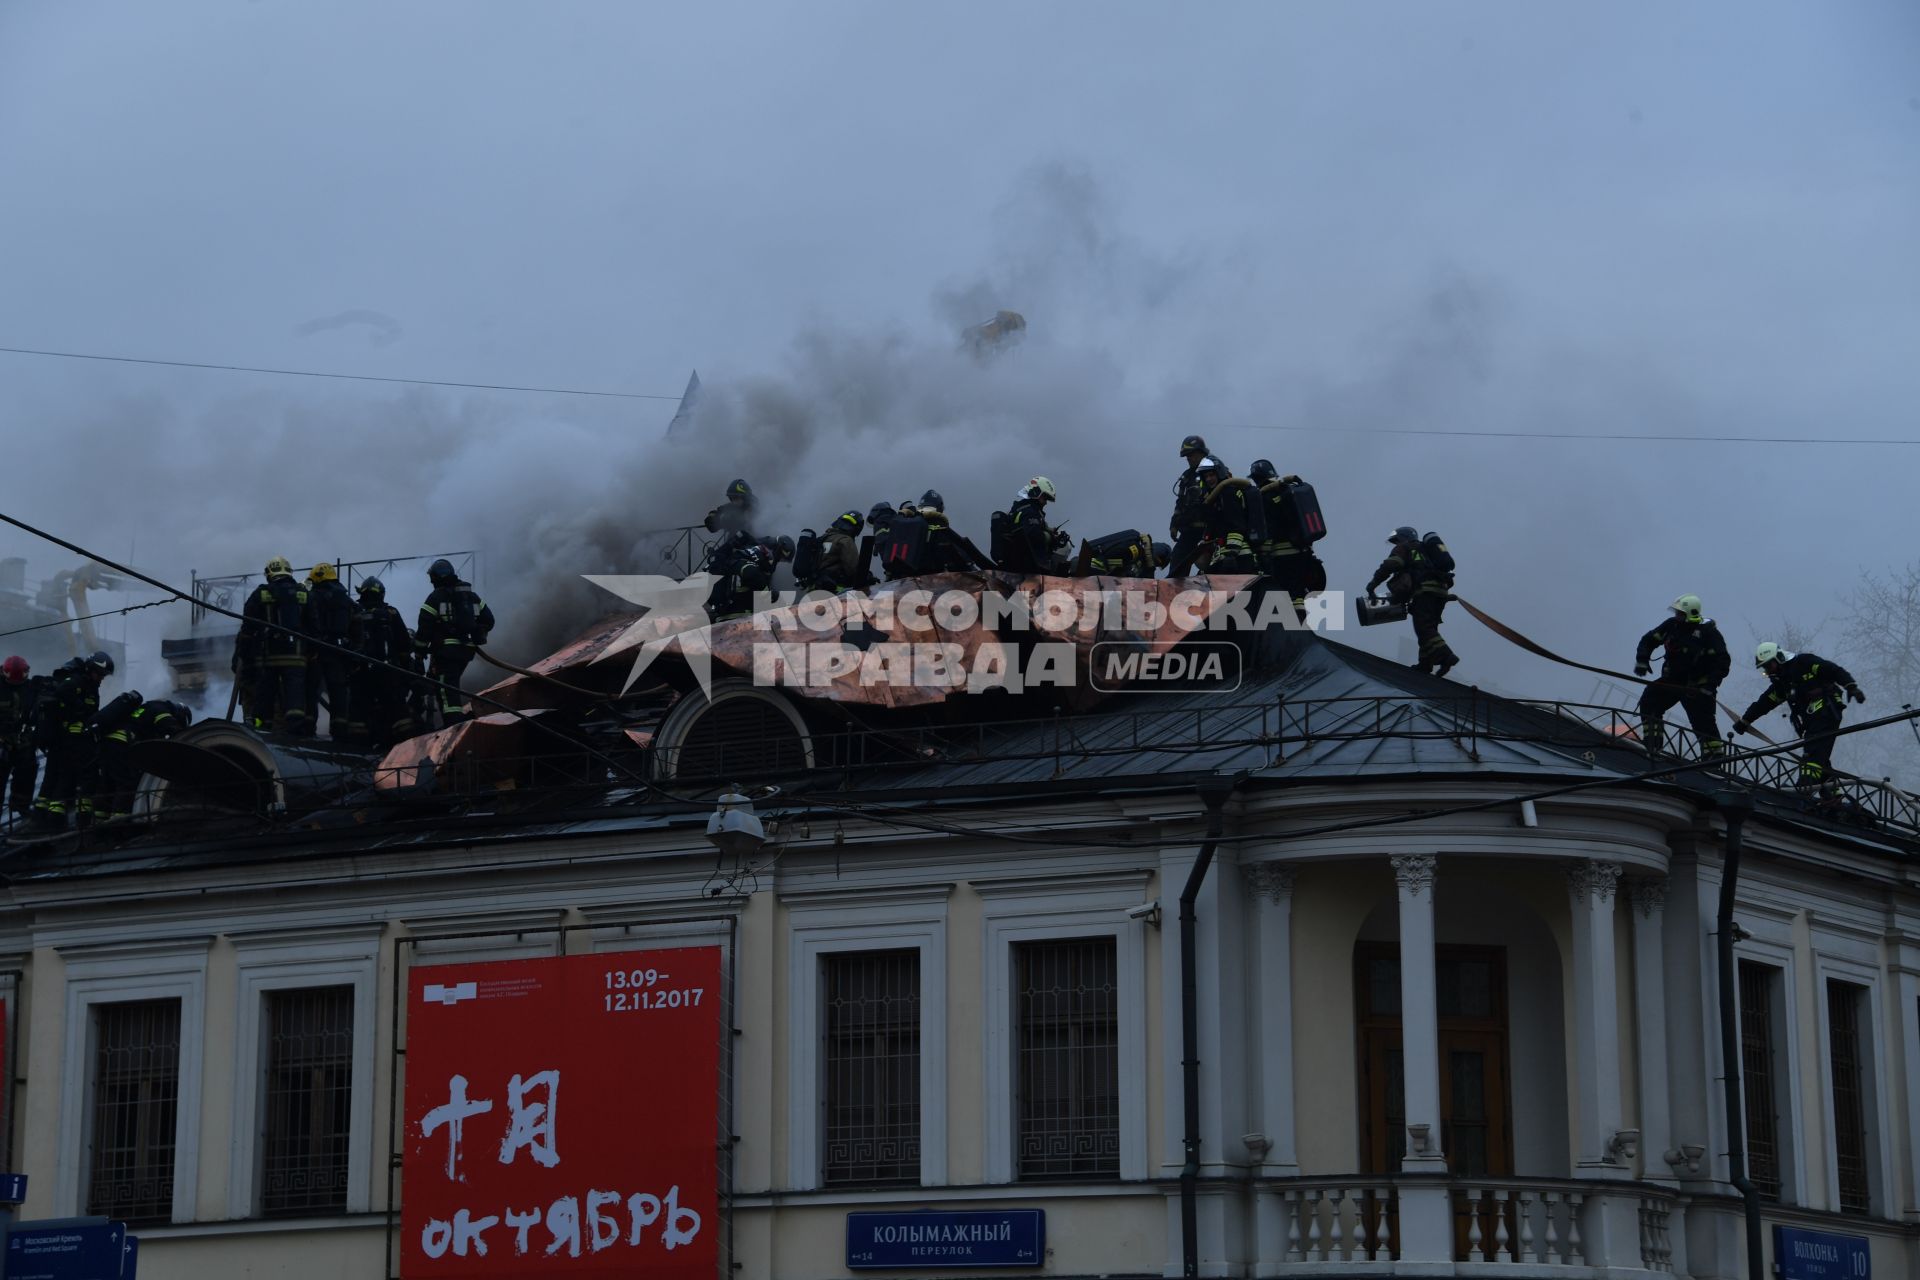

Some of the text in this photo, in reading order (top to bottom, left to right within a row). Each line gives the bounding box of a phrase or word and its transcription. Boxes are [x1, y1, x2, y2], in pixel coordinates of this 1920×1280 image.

[604, 988, 704, 1012] 12.11.2017
[873, 1220, 1011, 1243] КОЛЫМАЖНЫЙ
[862, 1252, 873, 1261] 14
[911, 1246, 973, 1256] ПЕРЕУЛОК
[1794, 1240, 1839, 1262] ВОЛХОНКА
[1852, 1251, 1866, 1277] 10
